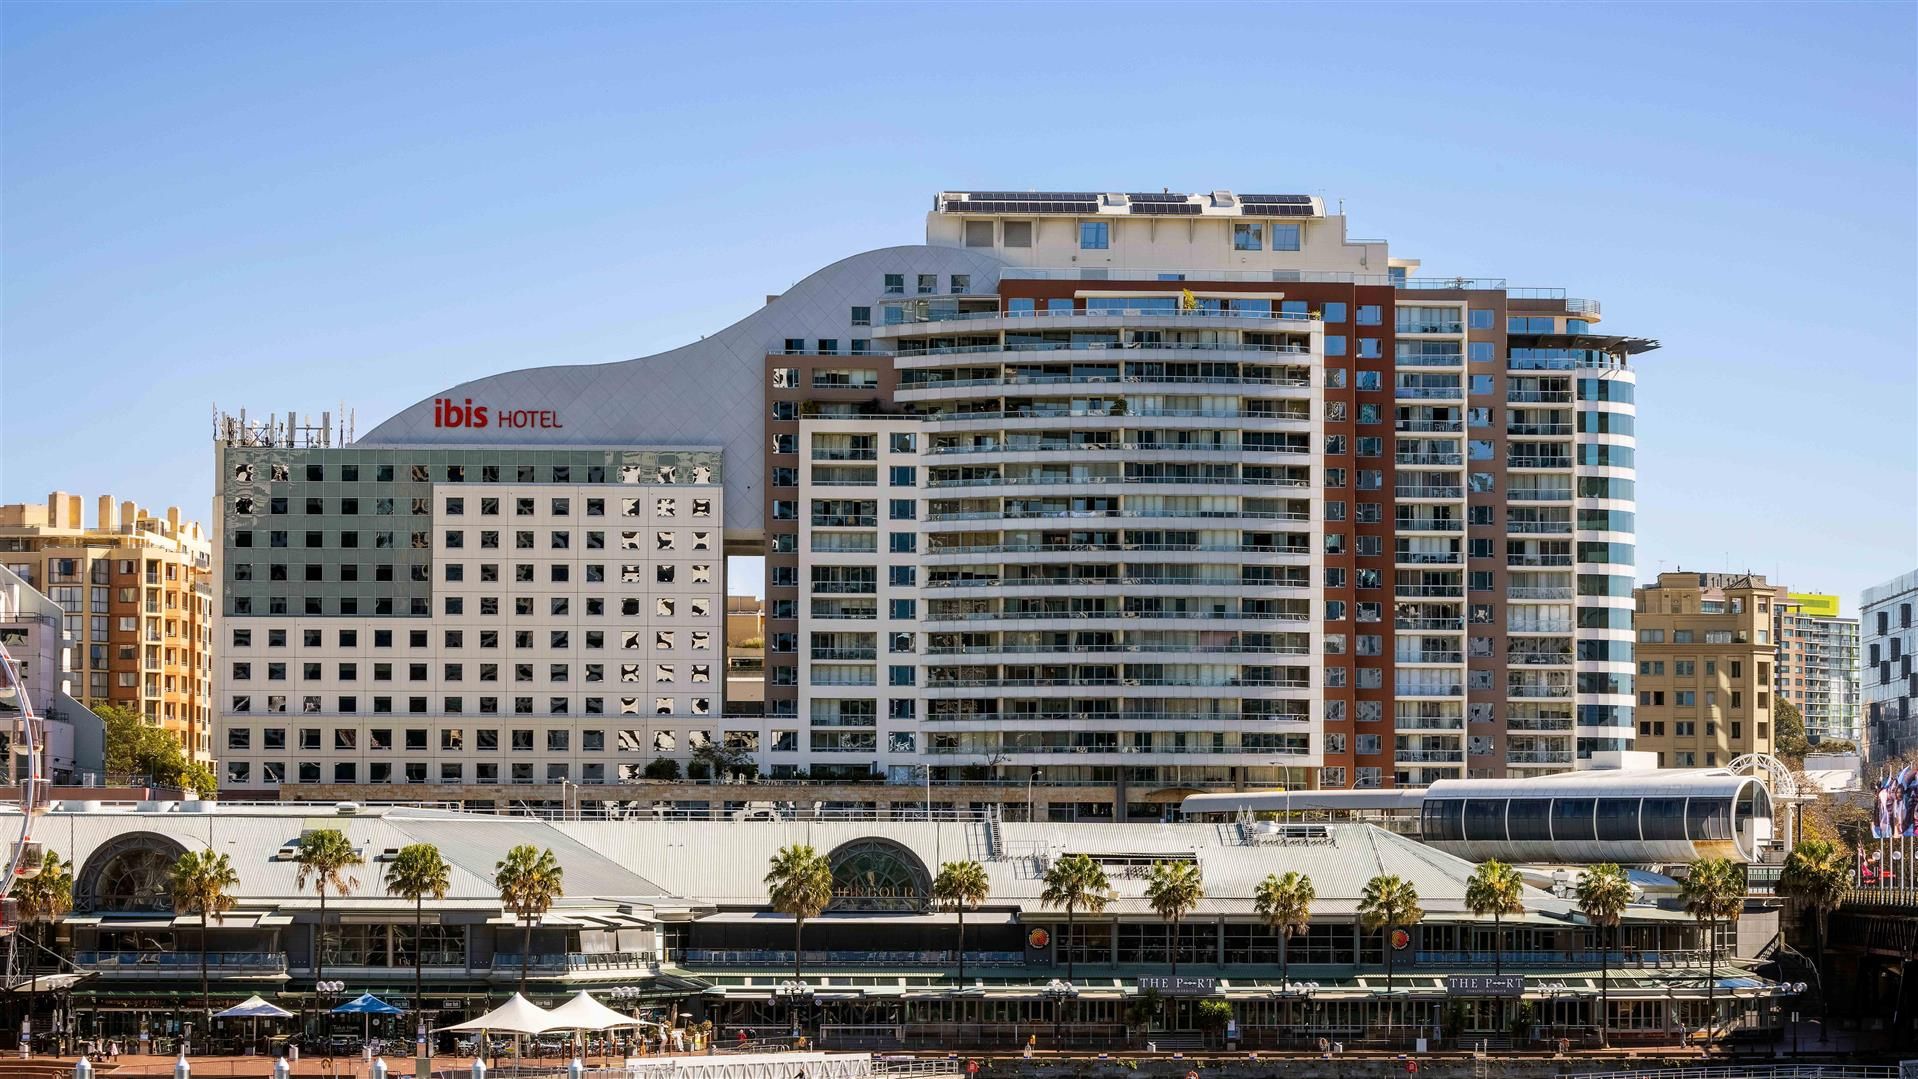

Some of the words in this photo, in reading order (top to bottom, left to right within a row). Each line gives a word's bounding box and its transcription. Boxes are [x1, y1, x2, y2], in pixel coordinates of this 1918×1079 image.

[434, 398, 488, 428] ibis
[498, 410, 563, 428] HOTEL
[1140, 978, 1169, 988] THE
[1176, 978, 1214, 988] PRT
[1449, 978, 1478, 988] THE
[1485, 978, 1523, 988] PRT
